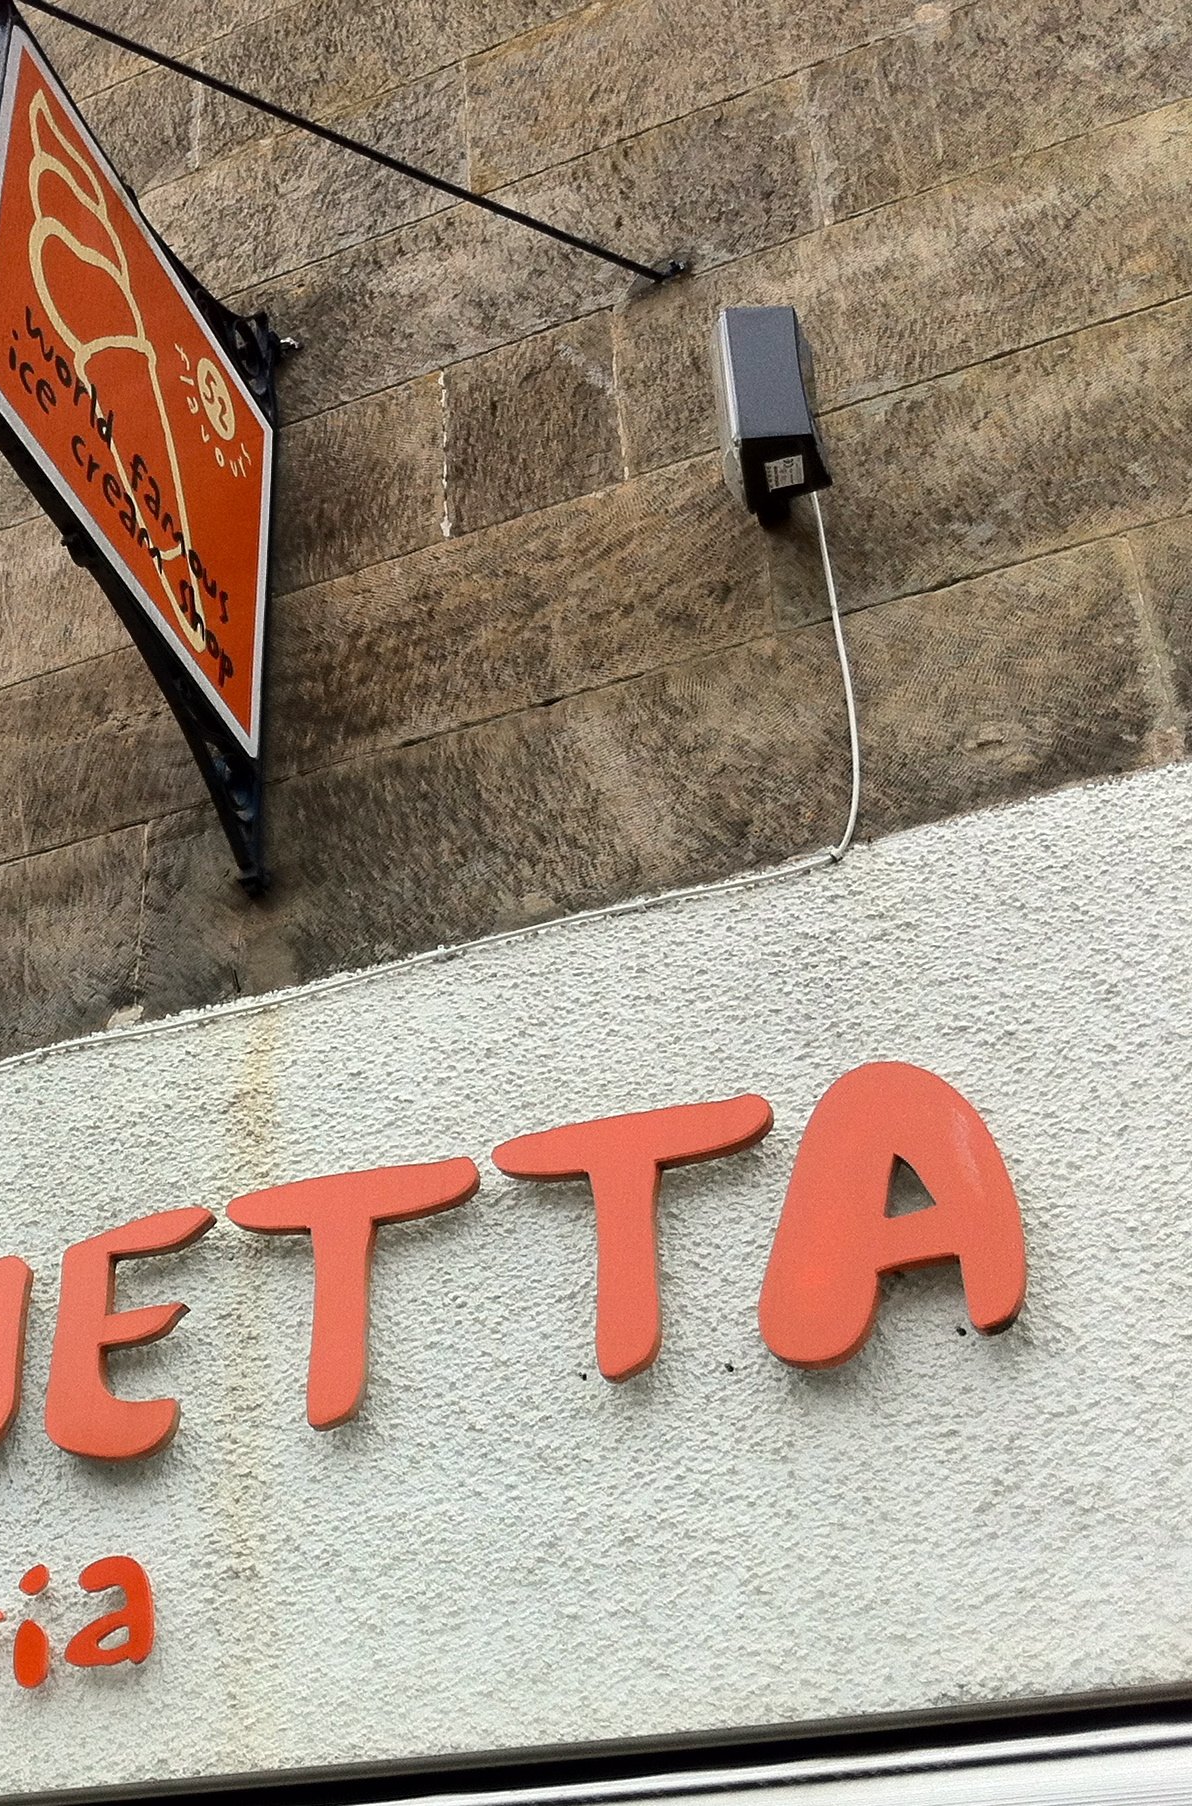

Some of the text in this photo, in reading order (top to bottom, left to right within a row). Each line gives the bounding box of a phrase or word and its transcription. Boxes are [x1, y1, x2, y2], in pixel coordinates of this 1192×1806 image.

[9, 329, 57, 414] ice
[71, 435, 163, 574] cream
[26, 306, 229, 624] world famous
[174, 343, 252, 478] flavours
[203, 370, 228, 432] 52
